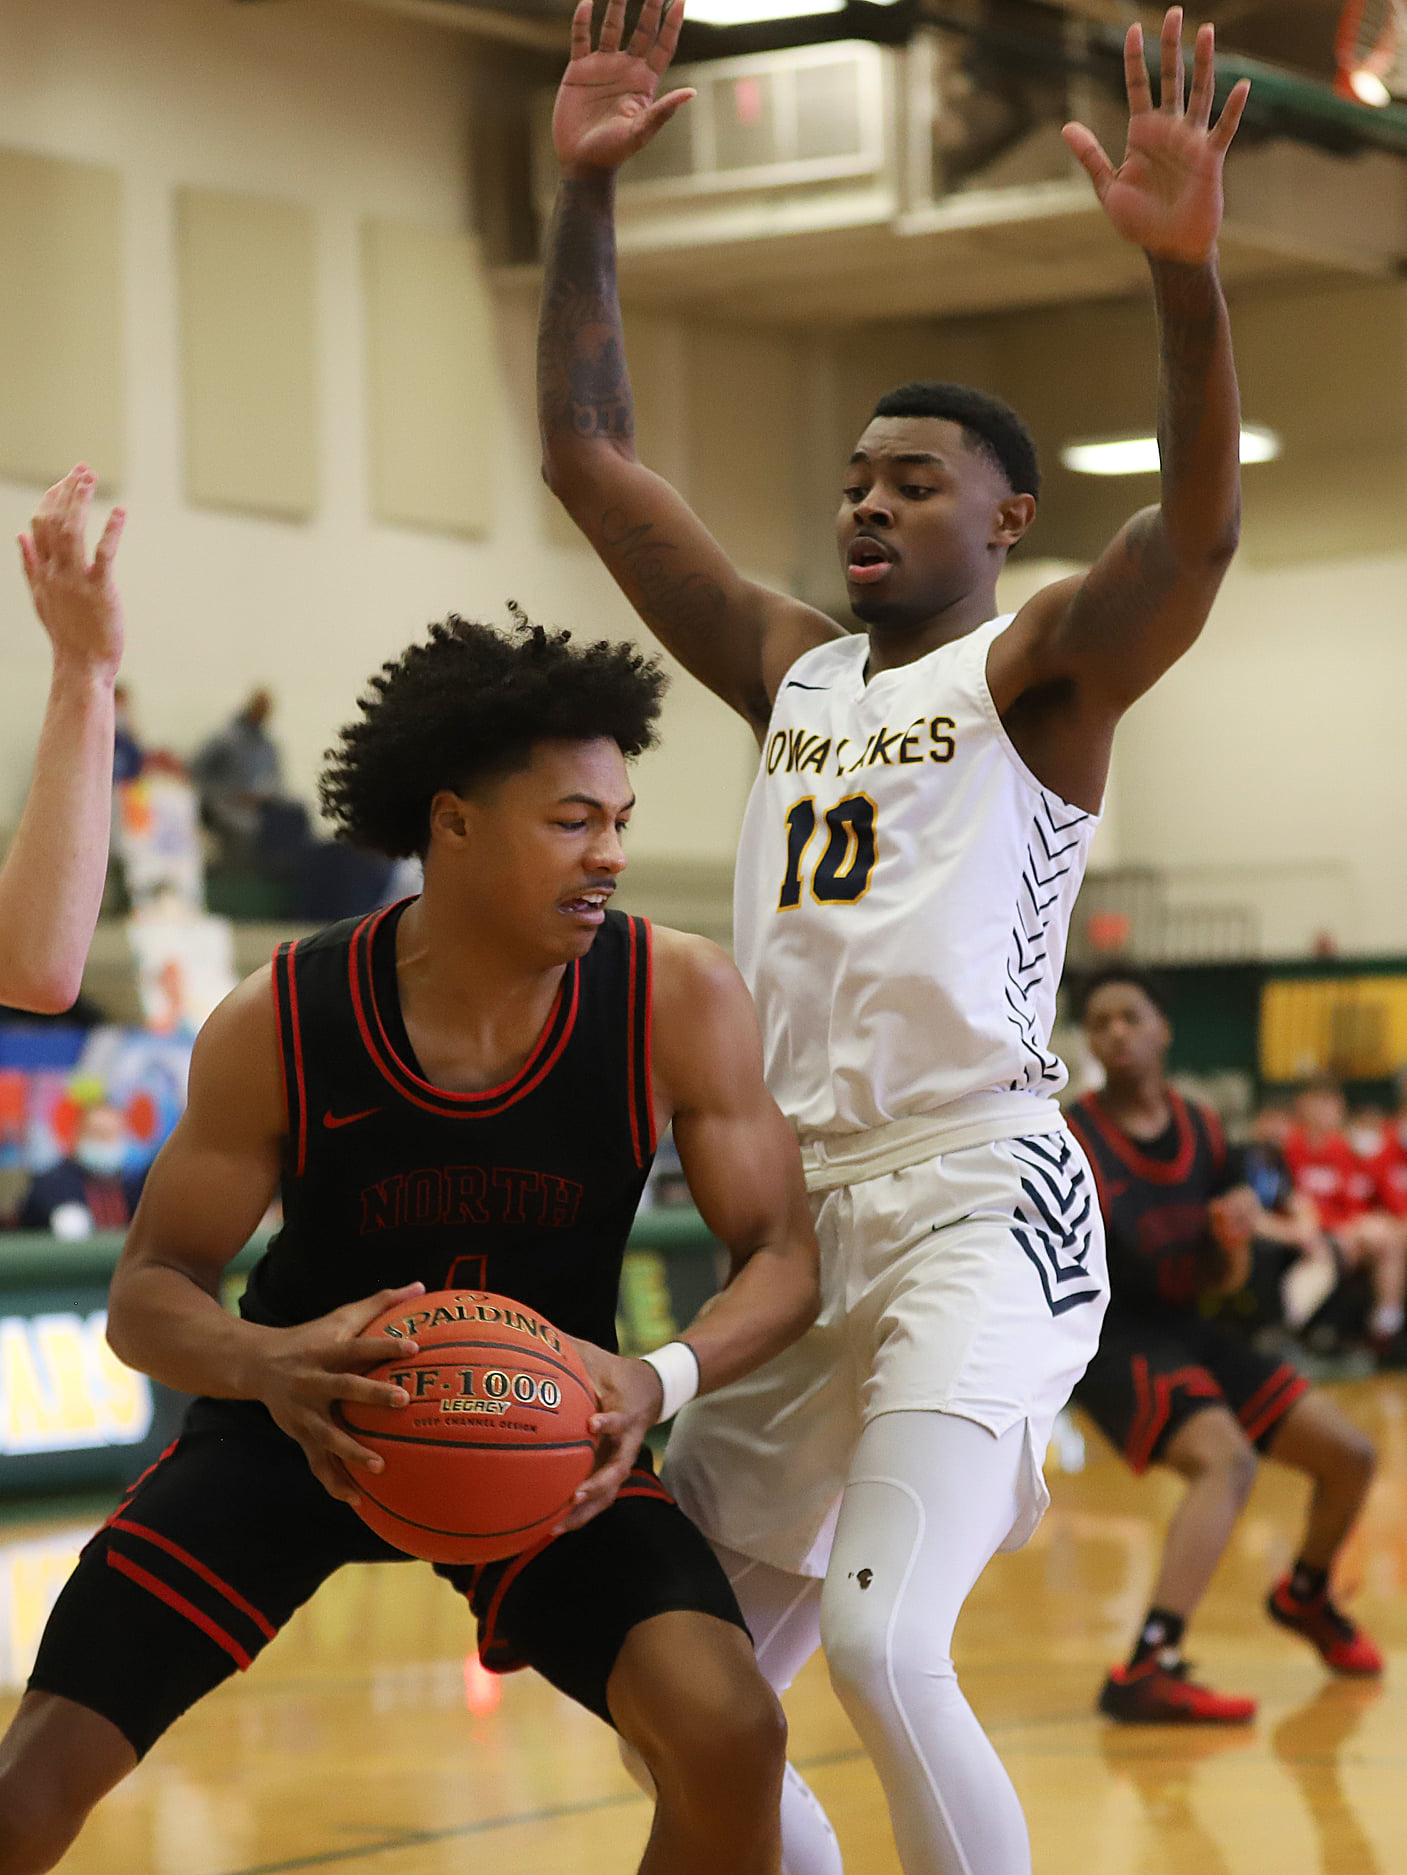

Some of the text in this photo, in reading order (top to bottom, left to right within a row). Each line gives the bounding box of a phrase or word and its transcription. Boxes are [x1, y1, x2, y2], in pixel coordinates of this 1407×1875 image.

[766, 728, 832, 776] OWA
[777, 791, 879, 913] 10
[360, 1165, 584, 1235] NORTH
[383, 1304, 562, 1356] SPALDING
[439, 1398, 511, 1415] LEGACY
[444, 1417, 495, 1428] CHANNEL
